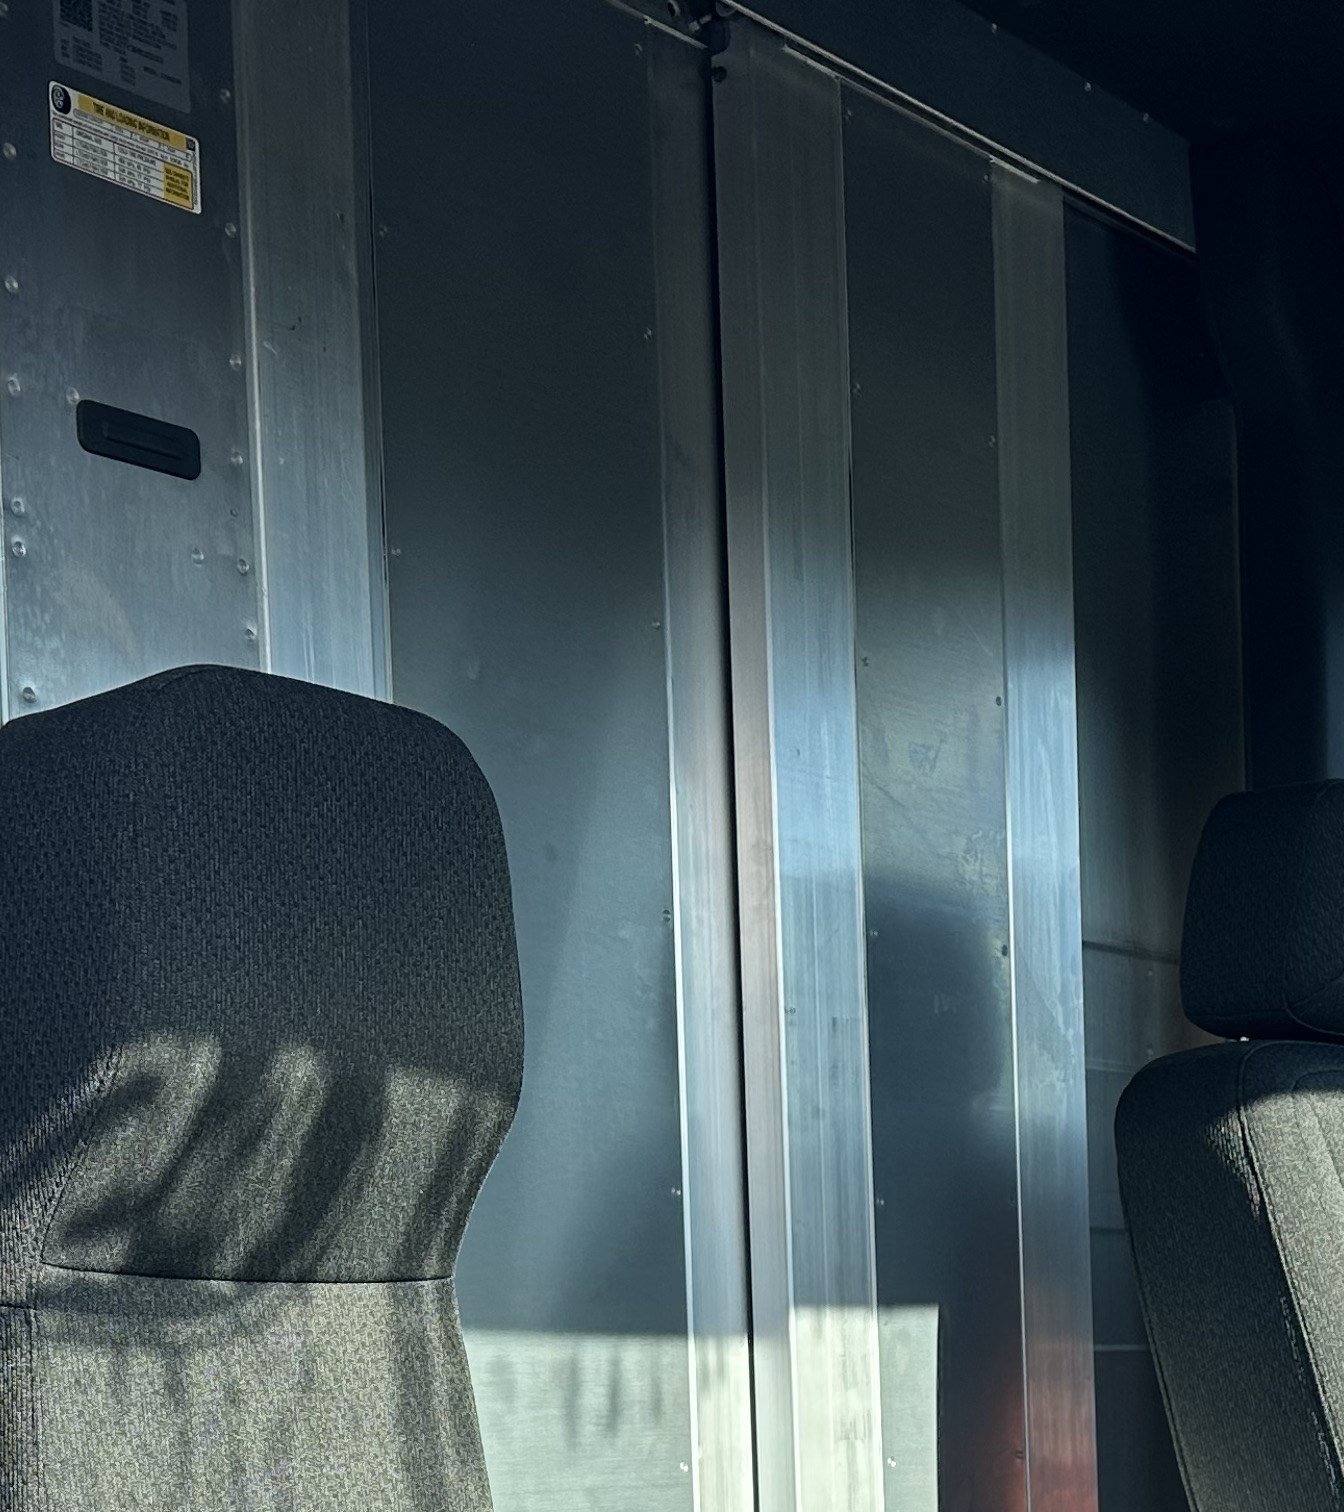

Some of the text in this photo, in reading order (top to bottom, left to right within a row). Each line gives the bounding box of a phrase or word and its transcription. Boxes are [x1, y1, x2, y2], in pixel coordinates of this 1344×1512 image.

[92, 101, 103, 115] TIRE
[105, 107, 115, 120] AND
[138, 120, 169, 142] INFORMATION
